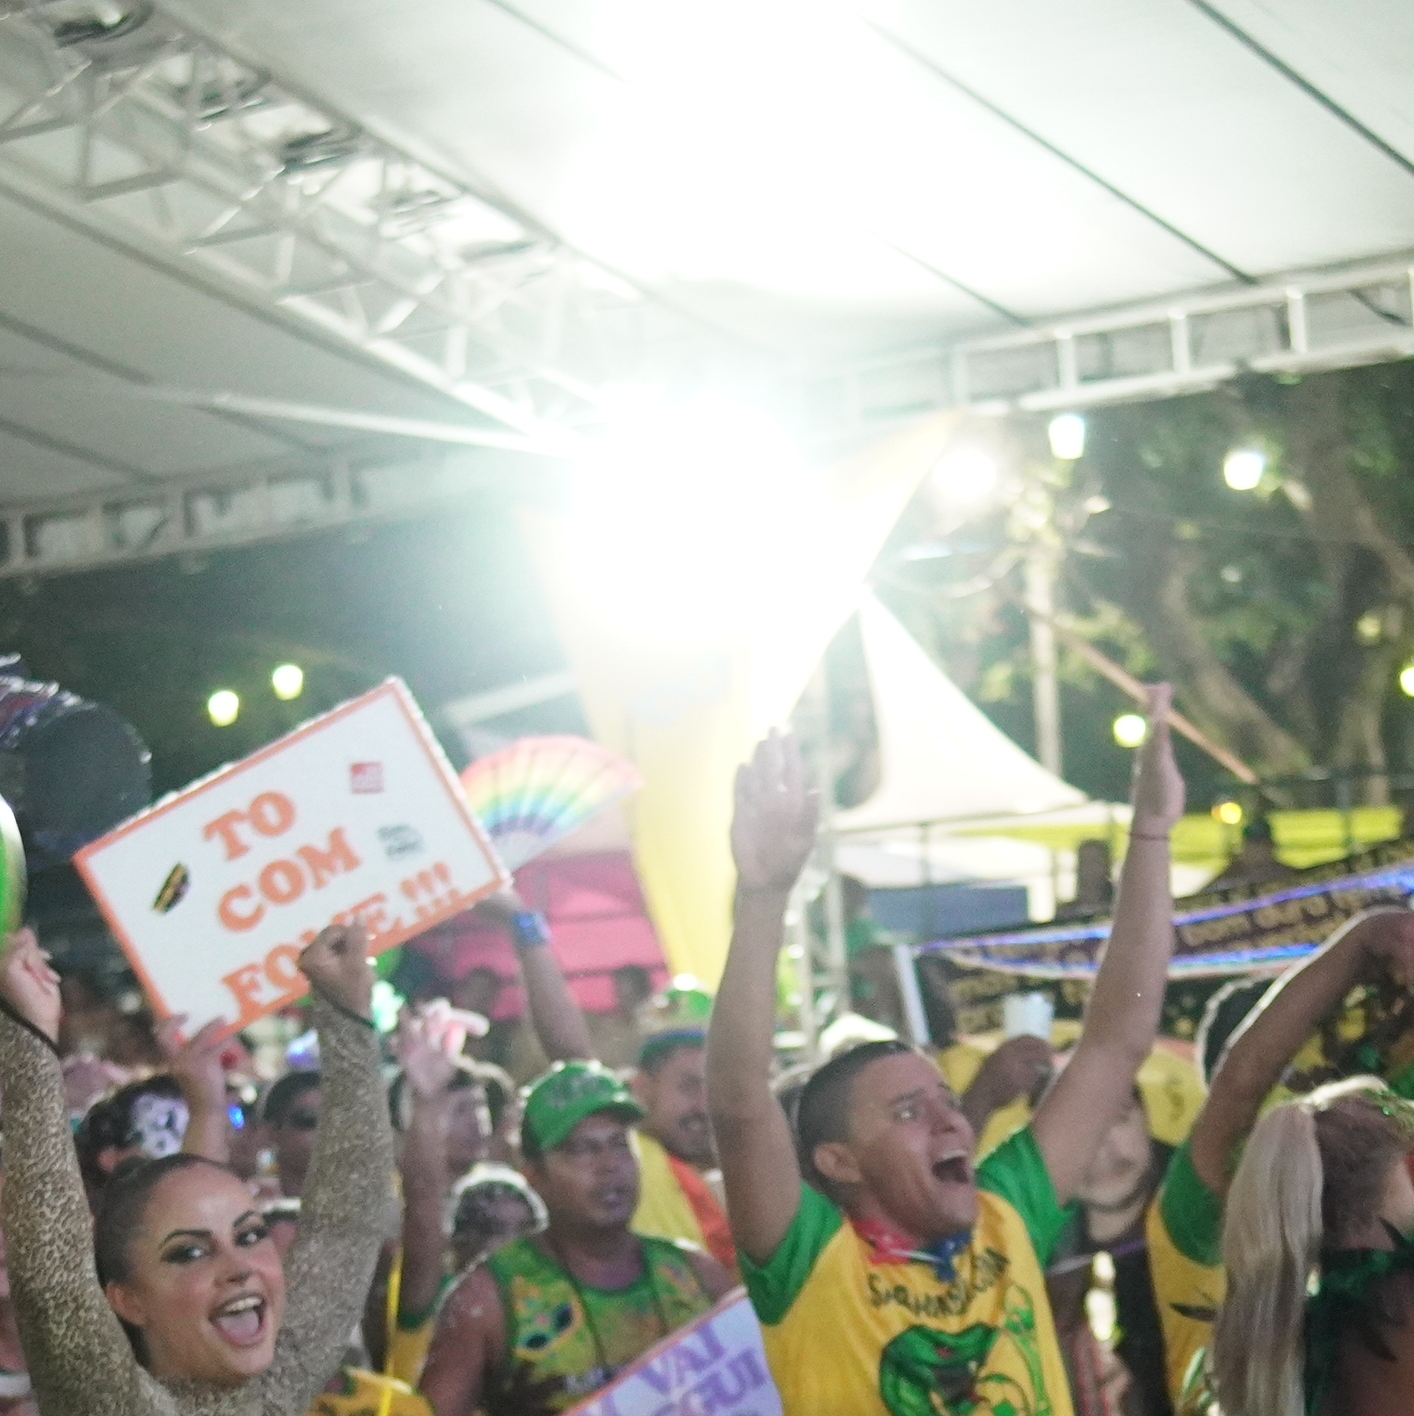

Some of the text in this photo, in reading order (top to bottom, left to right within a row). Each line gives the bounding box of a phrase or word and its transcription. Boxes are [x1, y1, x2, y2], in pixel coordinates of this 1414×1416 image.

[201, 790, 296, 862] TO
[216, 825, 364, 932] COM
[221, 860, 463, 1020] FOE!!!
